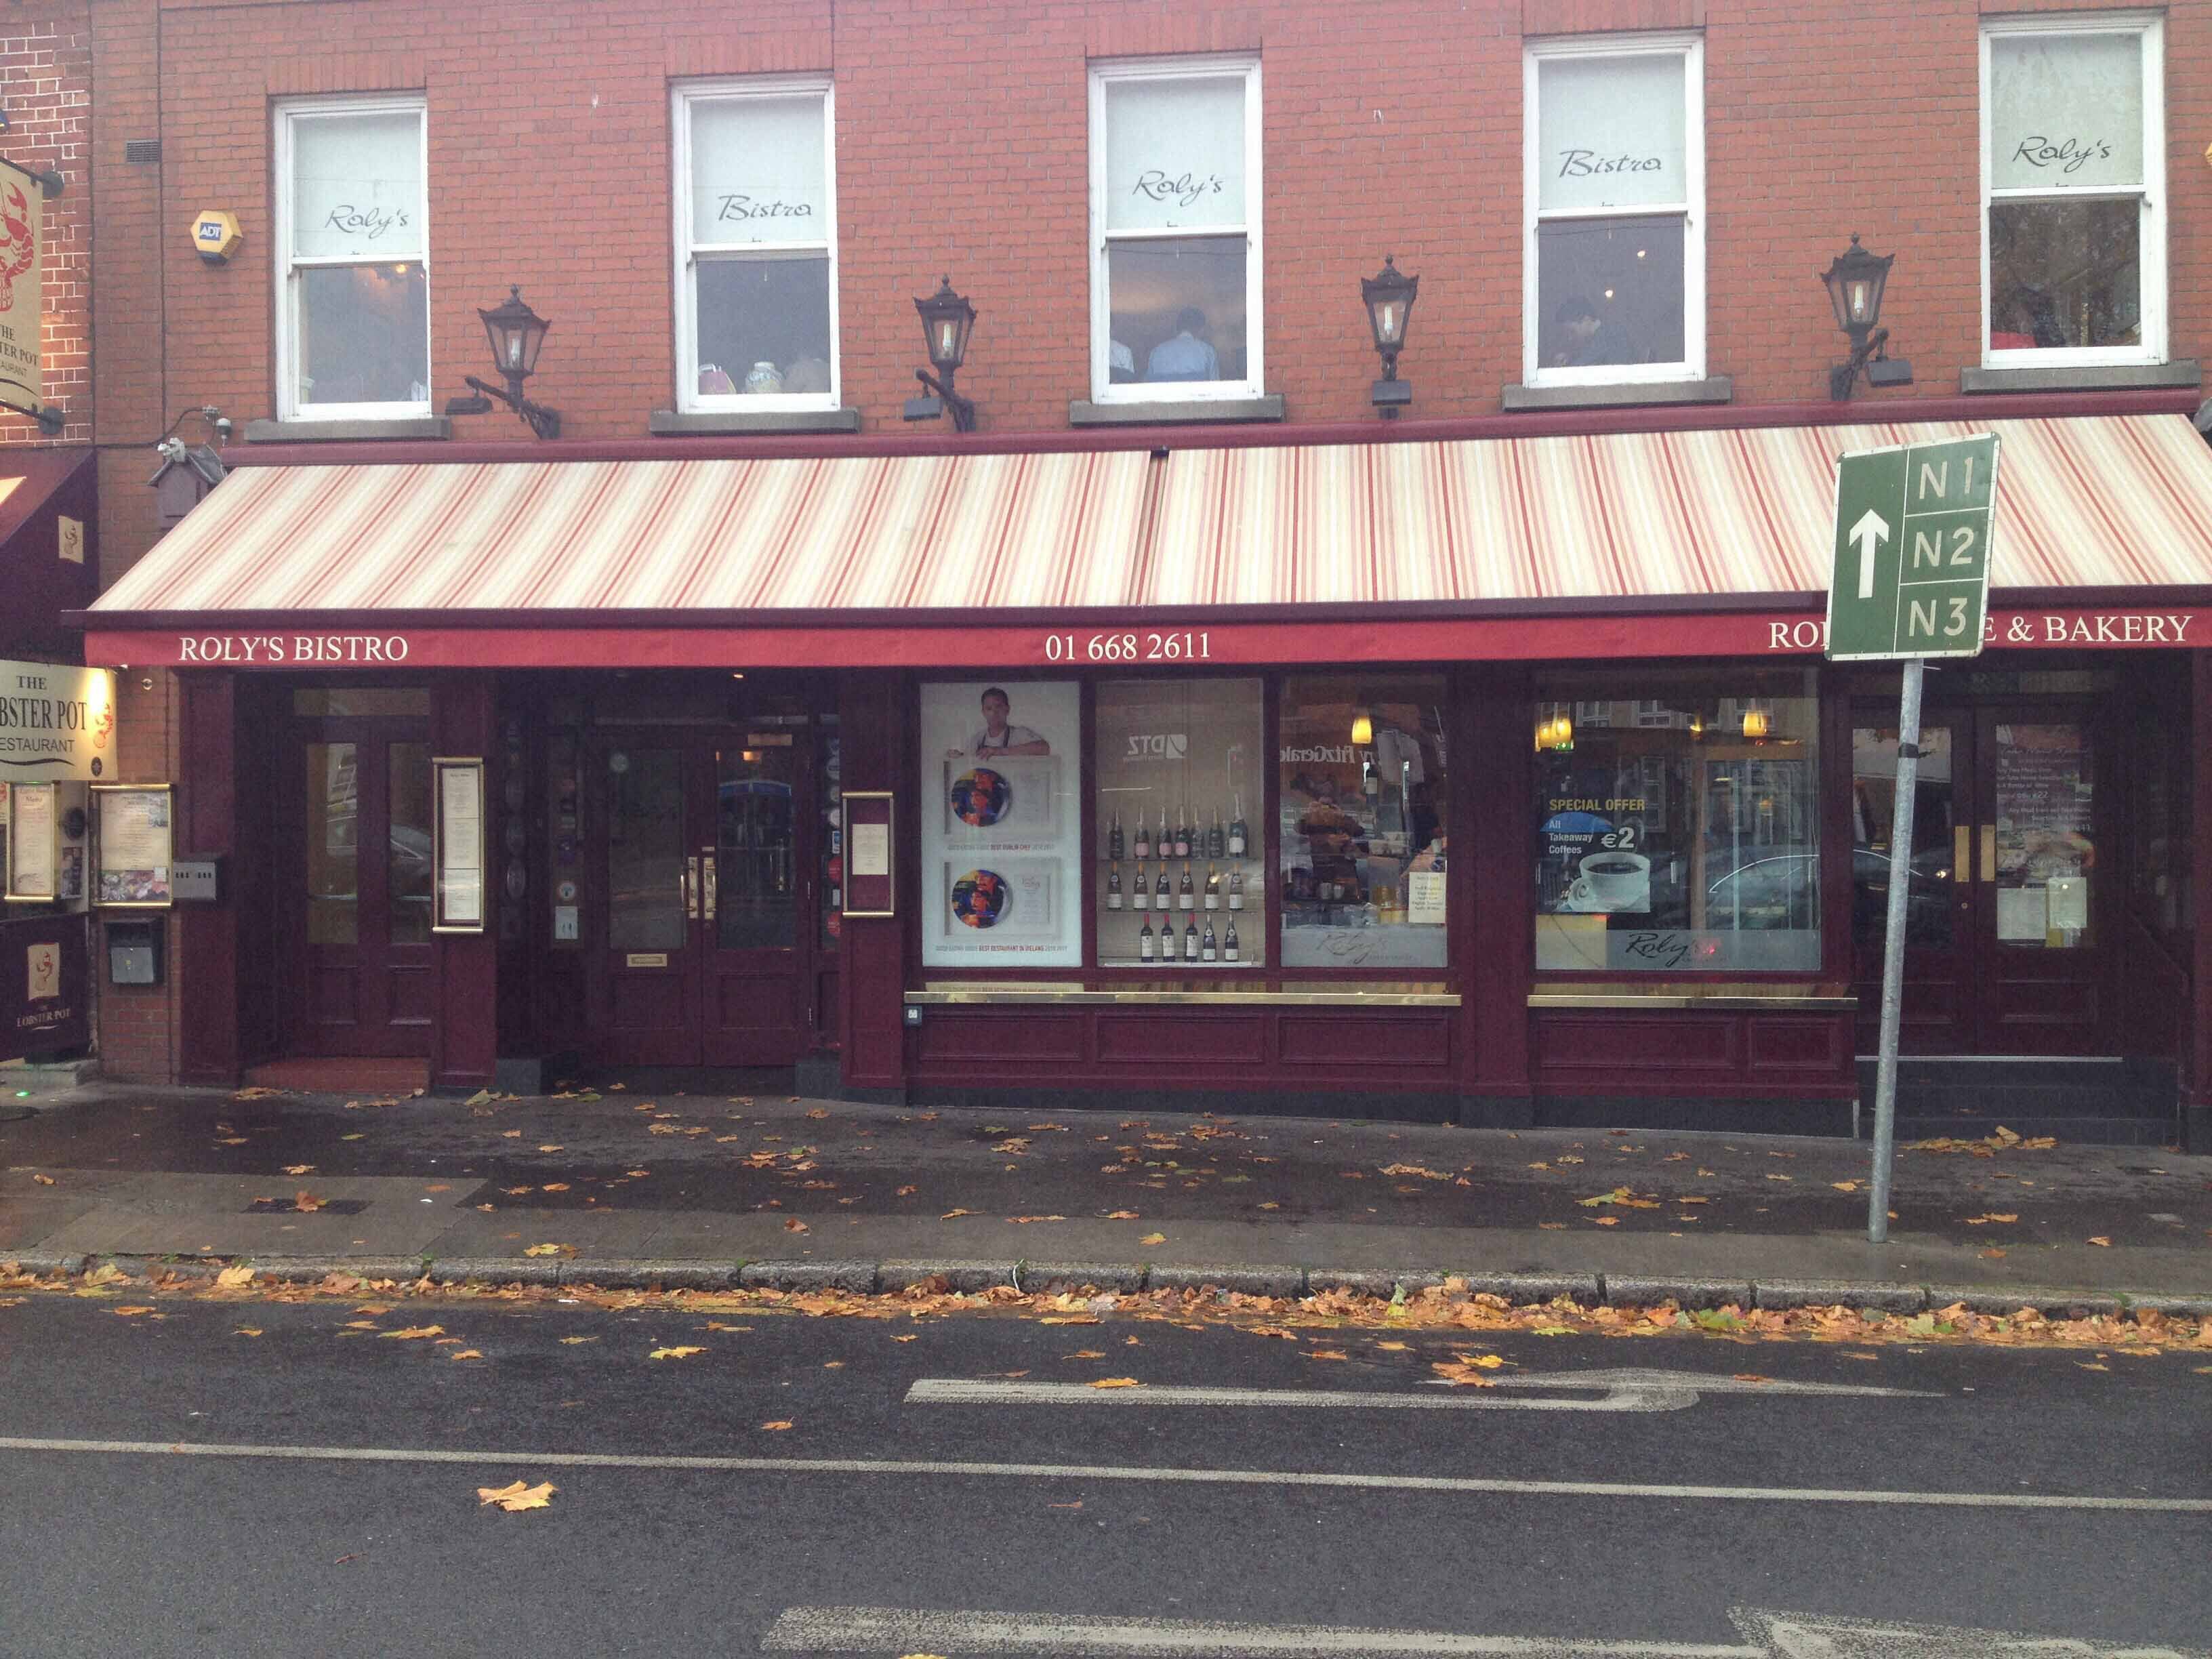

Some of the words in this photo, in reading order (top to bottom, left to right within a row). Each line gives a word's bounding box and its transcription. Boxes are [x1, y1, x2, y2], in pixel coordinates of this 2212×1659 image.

[1559, 150, 1662, 178] Bistro
[2013, 136, 2112, 173] Roly's
[1132, 170, 1226, 207] Roly's
[718, 194, 812, 222] Bistro
[200, 225, 221, 239] ADT
[325, 205, 409, 239] Roly's
[20, 348, 39, 366] POT
[1913, 527, 1974, 568] N2
[1908, 597, 1968, 637] N3
[2007, 616, 2035, 642] &
[2043, 615, 2194, 642] BAKERY
[178, 636, 285, 661] ROLY'S
[292, 636, 408, 661] BISTRO
[1046, 634, 1076, 660] 01
[1088, 634, 1137, 660] 668
[1147, 632, 1210, 659] 2611
[16, 676, 47, 690] THE
[57, 700, 87, 731] POT
[1549, 798, 1601, 811] SPECIAL
[1605, 798, 1645, 811] OFFER
[1549, 819, 1561, 829] All
[1549, 833, 1593, 844] Takeaway
[1549, 845, 1582, 855] Coffees
[54, 1007, 71, 1021] POT
